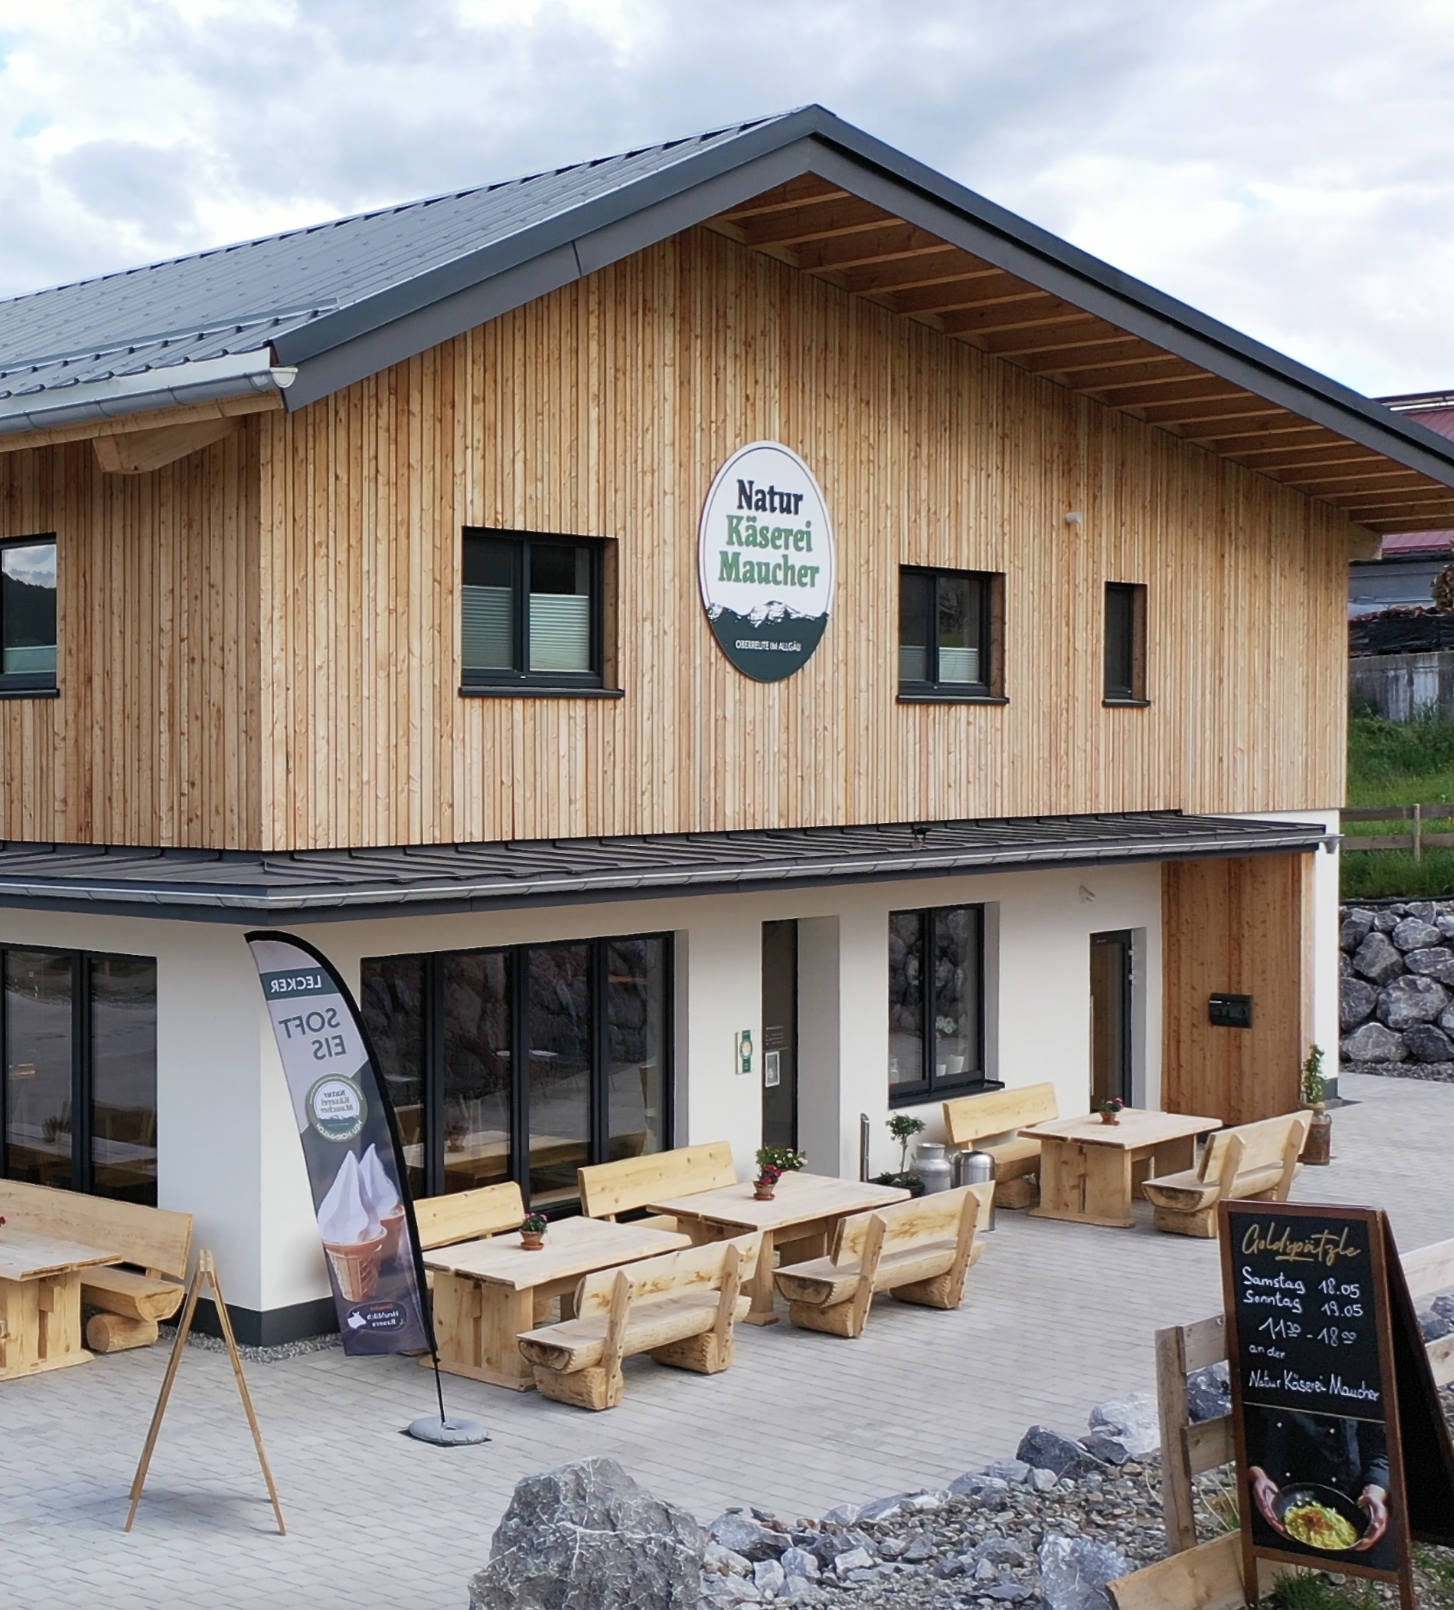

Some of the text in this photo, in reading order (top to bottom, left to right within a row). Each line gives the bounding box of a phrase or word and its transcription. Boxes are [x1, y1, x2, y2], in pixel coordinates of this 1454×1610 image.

[736, 479, 804, 515] Natur
[726, 514, 813, 552] Käserei
[718, 550, 820, 588] Maucher
[1242, 1222, 1362, 1267] Goldspätzle
[1242, 1266, 1361, 1299] Samstag 18.05
[1243, 1290, 1364, 1318] Sonntag 19.05
[1249, 1344, 1286, 1359] an der
[1249, 1369, 1380, 1401] Natur Käserei Maucher
